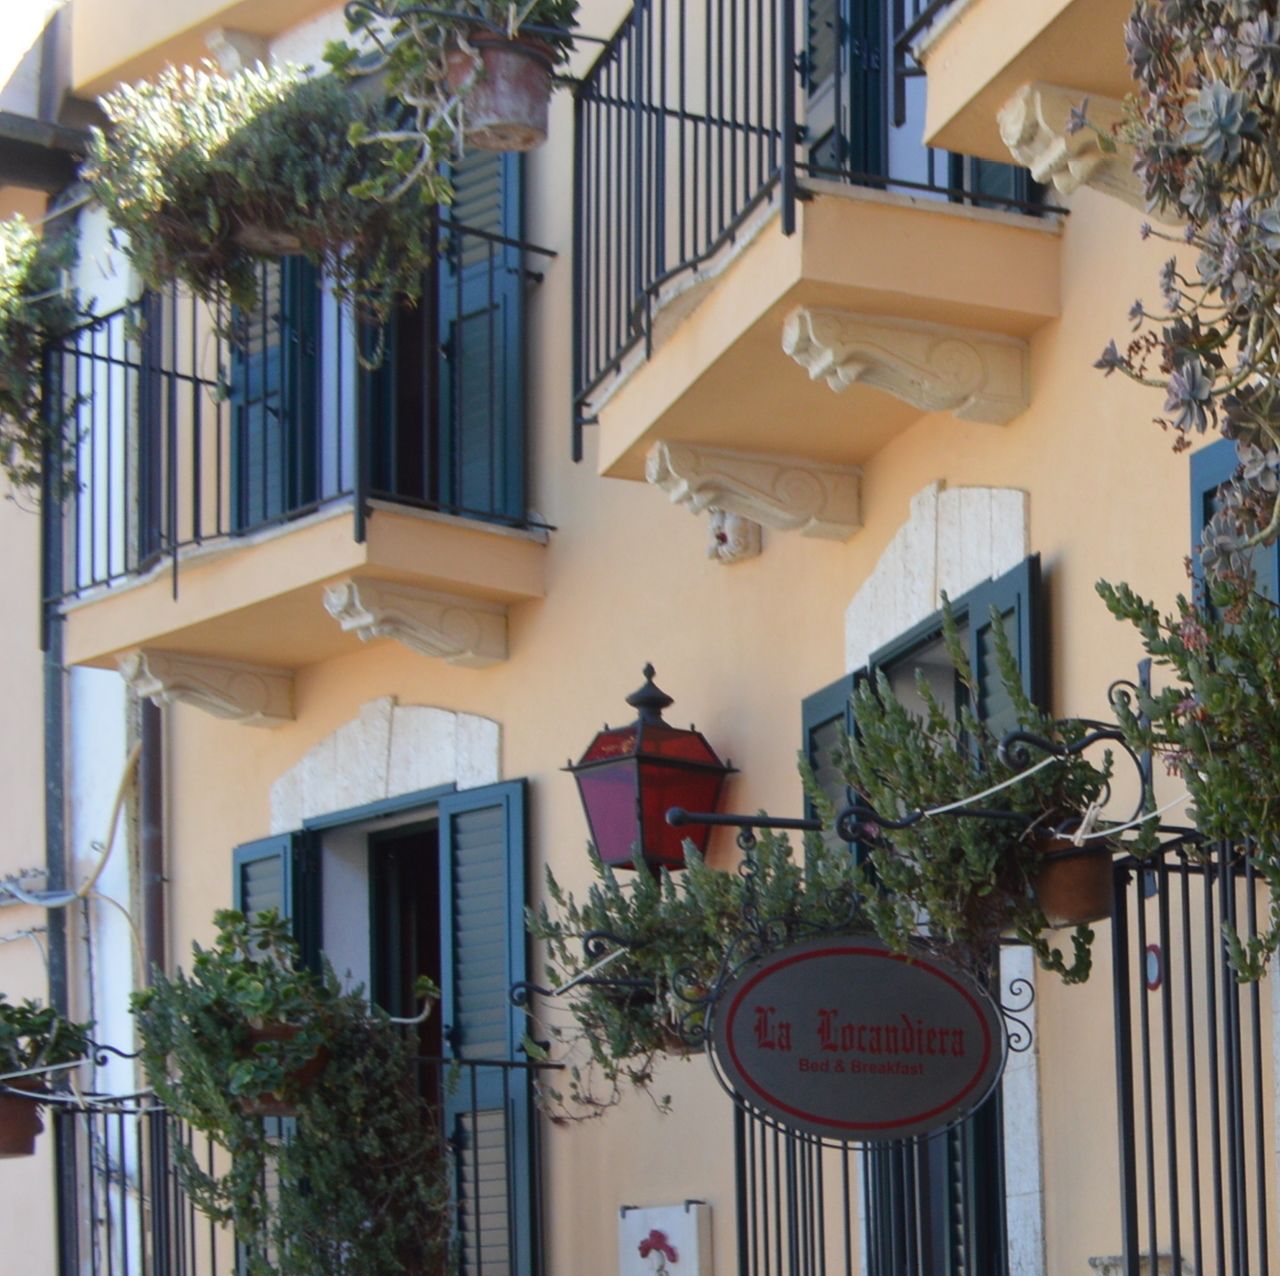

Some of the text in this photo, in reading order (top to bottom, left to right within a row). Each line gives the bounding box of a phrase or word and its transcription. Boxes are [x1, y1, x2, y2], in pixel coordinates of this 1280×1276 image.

[753, 1006, 966, 1057] La Locandiera
[799, 1058, 924, 1076] Bed & Breakfast
